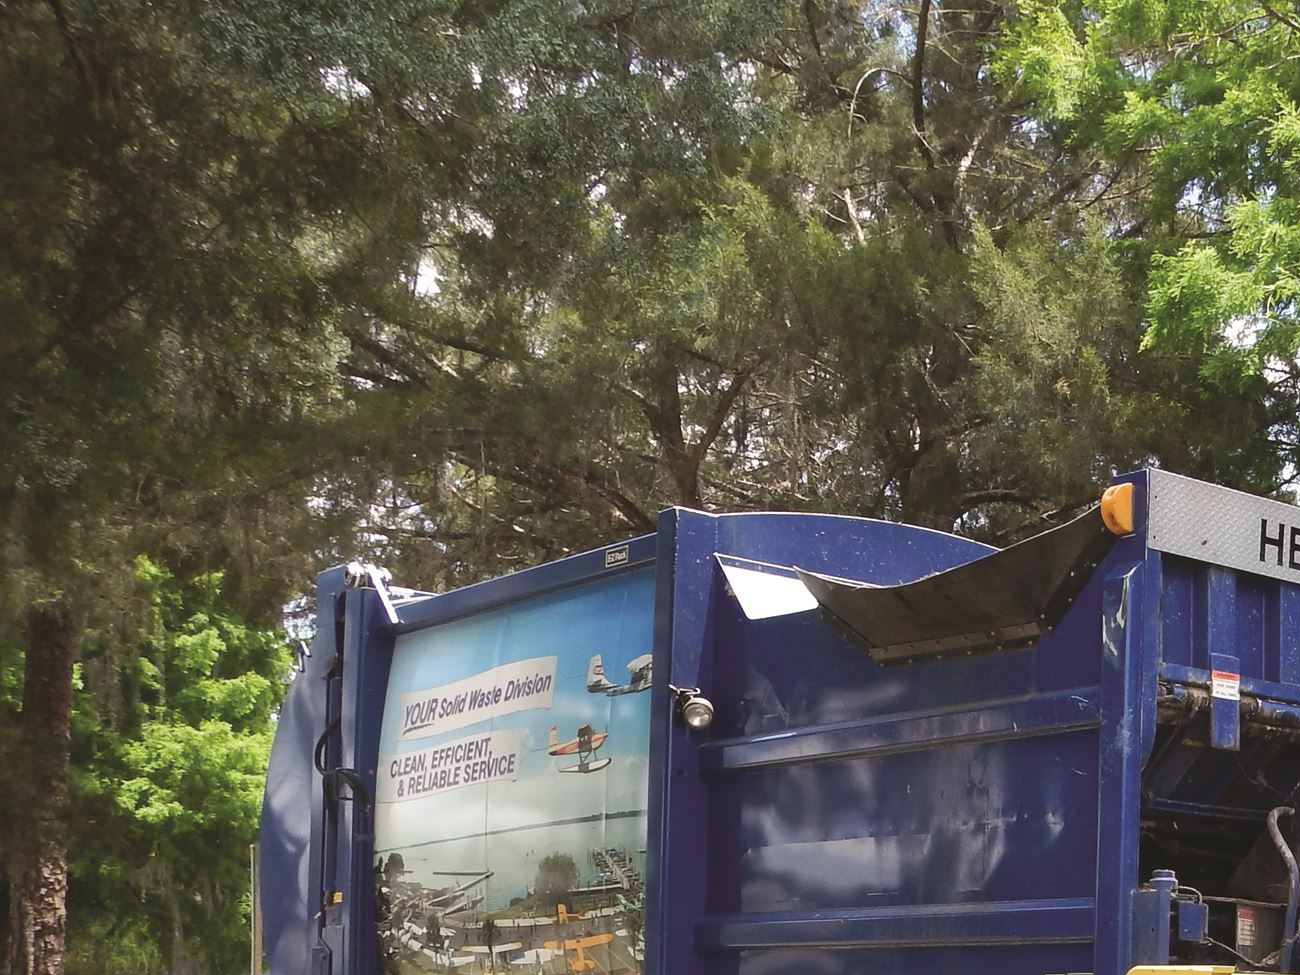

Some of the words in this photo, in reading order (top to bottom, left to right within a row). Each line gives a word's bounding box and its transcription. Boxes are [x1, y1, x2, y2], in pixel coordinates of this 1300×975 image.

[404, 698, 438, 728] YOUR
[439, 691, 468, 718] Solid
[468, 685, 502, 711] Waste
[504, 674, 552, 702] Division
[390, 753, 428, 778] CLEAN,
[431, 737, 493, 769] EFFICIENT,
[397, 779, 405, 797] &
[407, 766, 461, 796] RELIABLE
[463, 753, 516, 783] SERVICE
